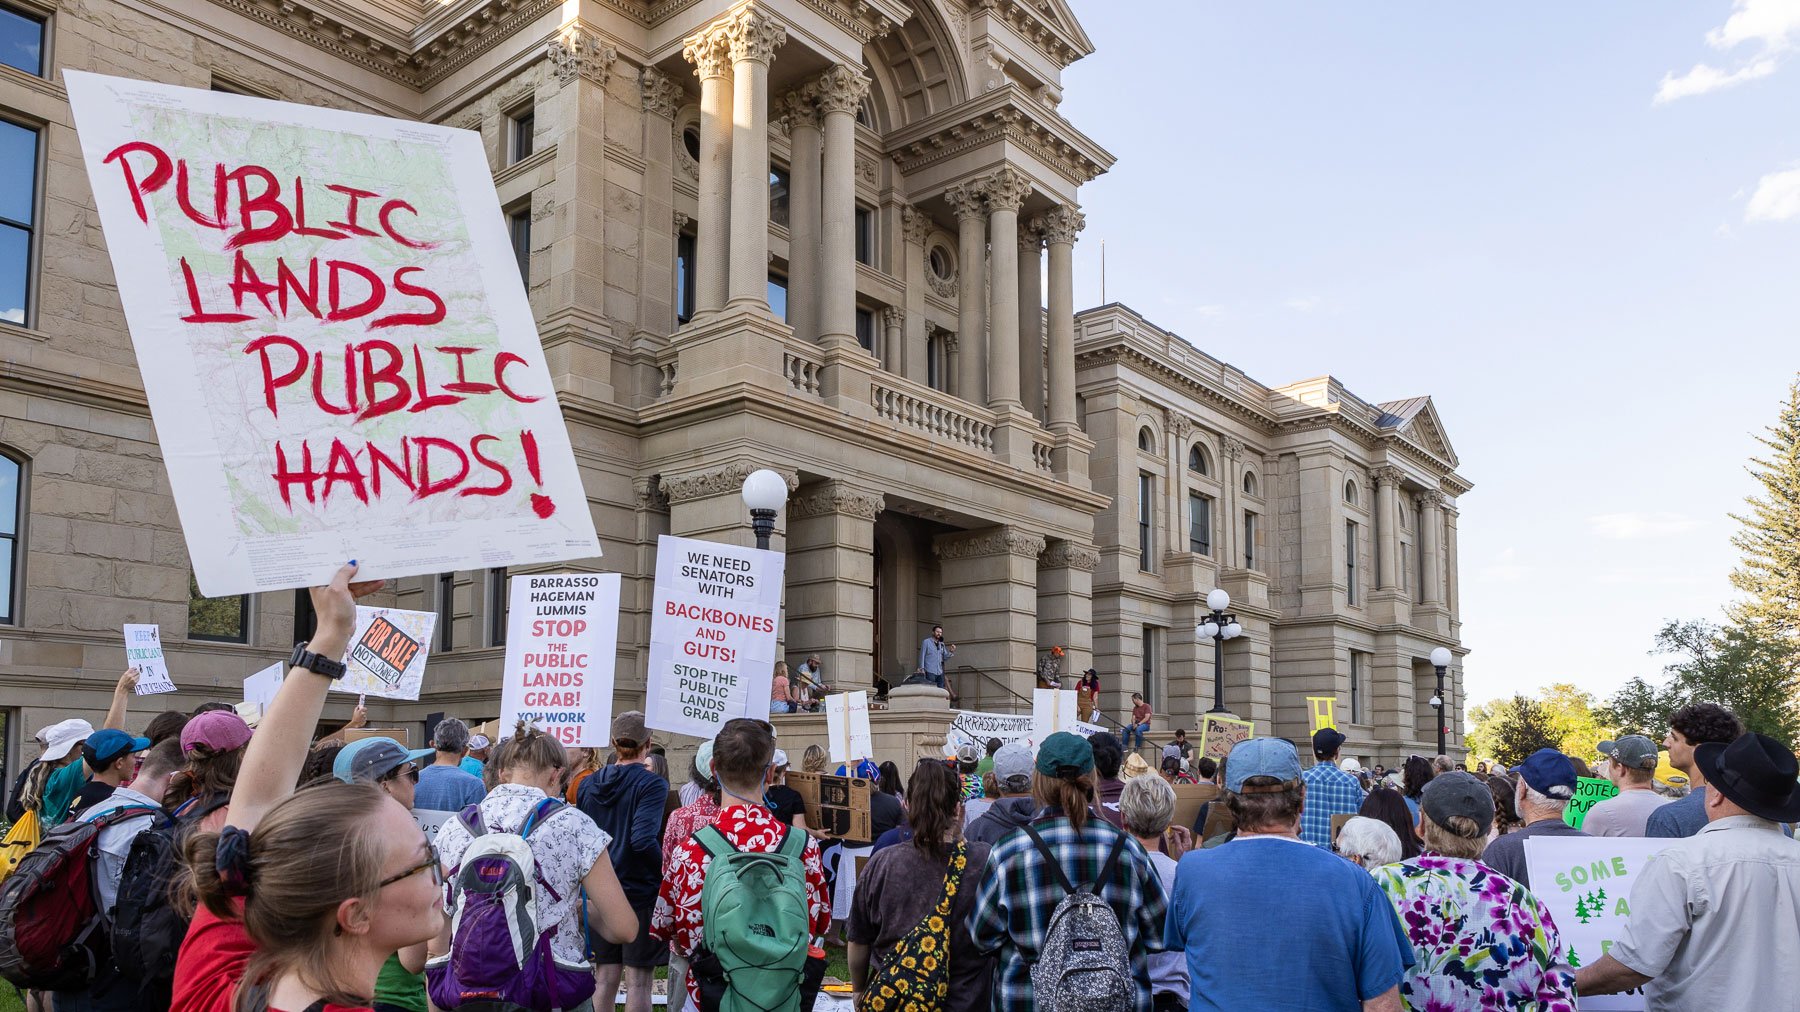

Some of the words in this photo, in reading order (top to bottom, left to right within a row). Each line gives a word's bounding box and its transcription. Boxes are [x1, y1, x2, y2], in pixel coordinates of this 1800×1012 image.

[103, 141, 444, 251] PUBLIC
[180, 249, 447, 332] LANDS
[243, 334, 545, 424] PUBLIC
[272, 429, 556, 519] HANDS!
[687, 551, 709, 566] WE
[713, 555, 751, 572] NEED
[530, 577, 599, 589] BARRASSO
[681, 565, 754, 588] SENATORS
[530, 591, 595, 602] HAGEMAN
[698, 582, 734, 599] WITH
[536, 605, 587, 616] LUMMIS
[665, 600, 774, 633] BACKBONES
[134, 630, 151, 641] KEEP
[531, 620, 587, 637] STOP
[695, 627, 726, 642] AND
[361, 617, 393, 653] FOR
[381, 632, 418, 672] SALE
[547, 643, 568, 652] THE
[684, 641, 736, 663] GUTS!
[354, 645, 376, 664] NOT
[376, 661, 399, 683] OWNER
[523, 653, 588, 668] PUBLIC
[146, 665, 154, 677] IN
[522, 672, 584, 687] LANDS
[673, 663, 708, 678] STOP
[711, 671, 738, 687] THE
[679, 678, 729, 699] PUBLIC
[524, 691, 581, 707] GRAB!
[680, 692, 725, 712] LANDS
[517, 712, 542, 723] YOU
[545, 712, 586, 723] WORK
[682, 706, 720, 723] GRAB
[1575, 781, 1619, 797] ROTEC
[1555, 856, 1628, 893] SOME
